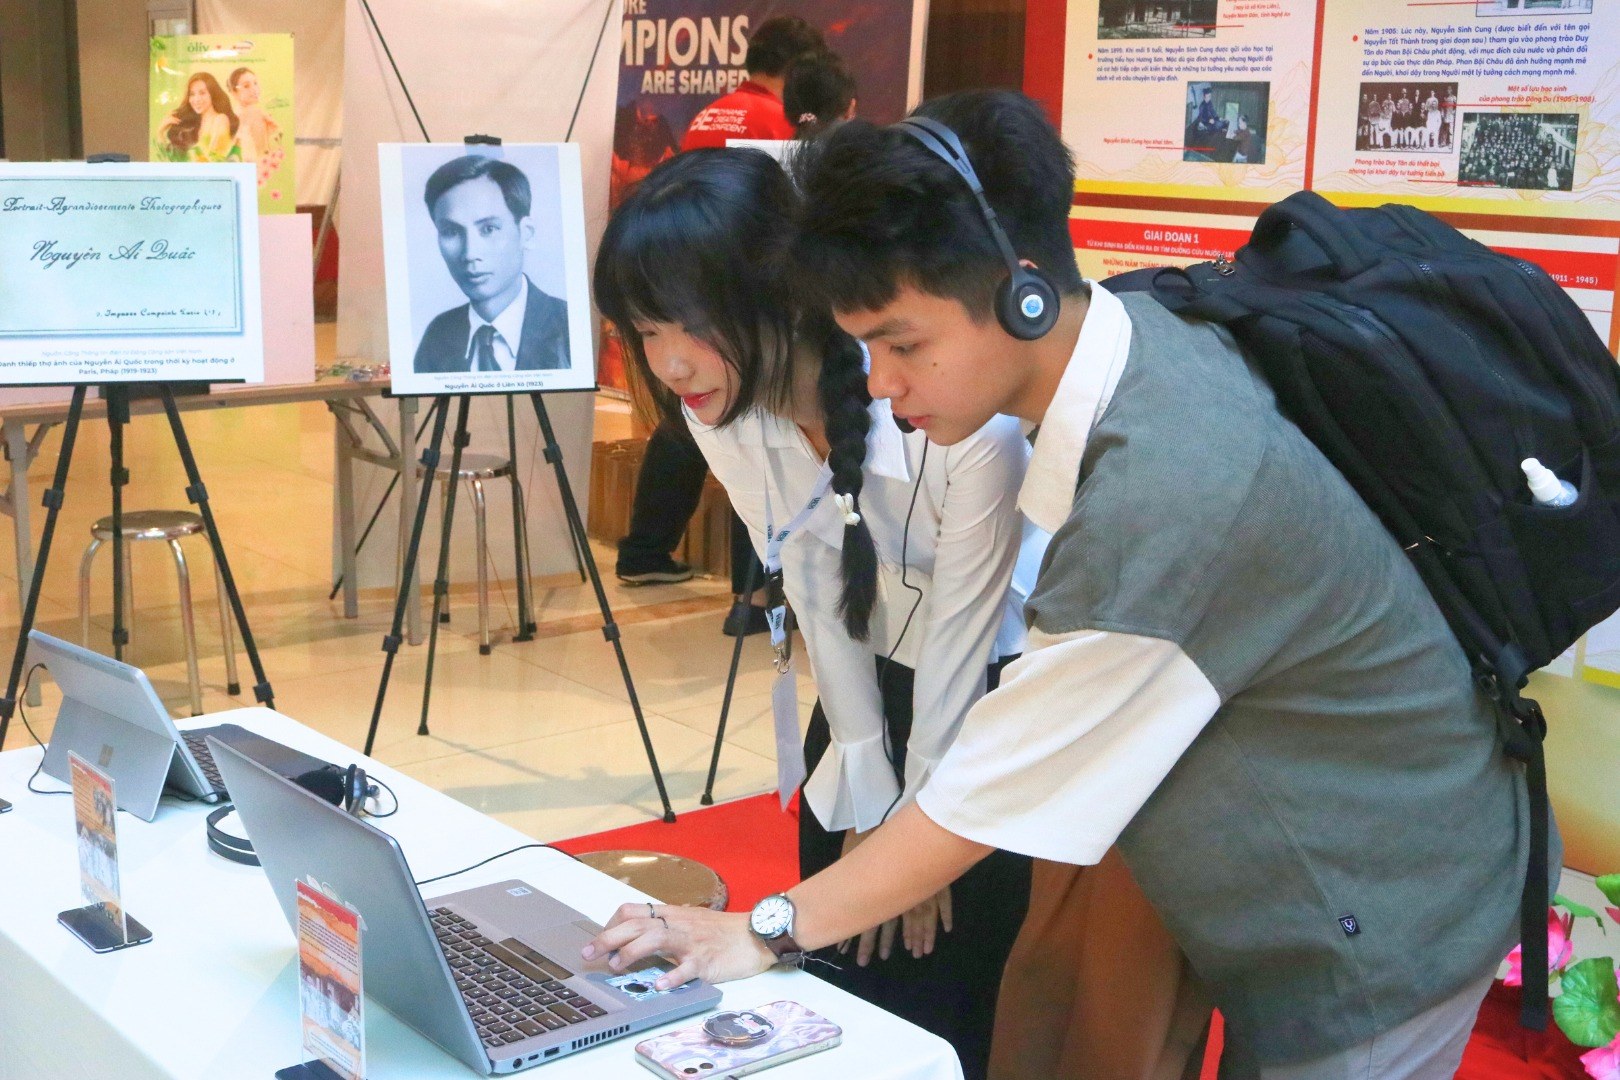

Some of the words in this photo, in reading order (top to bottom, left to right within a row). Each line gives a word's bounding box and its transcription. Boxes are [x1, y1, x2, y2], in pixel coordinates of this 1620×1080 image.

[641, 69, 675, 94] ARE
[1144, 230, 1162, 241] GIAI
[1165, 232, 1191, 245] ĐOẠN
[1194, 234, 1199, 244] 1
[1576, 275, 1598, 286] 1945)
